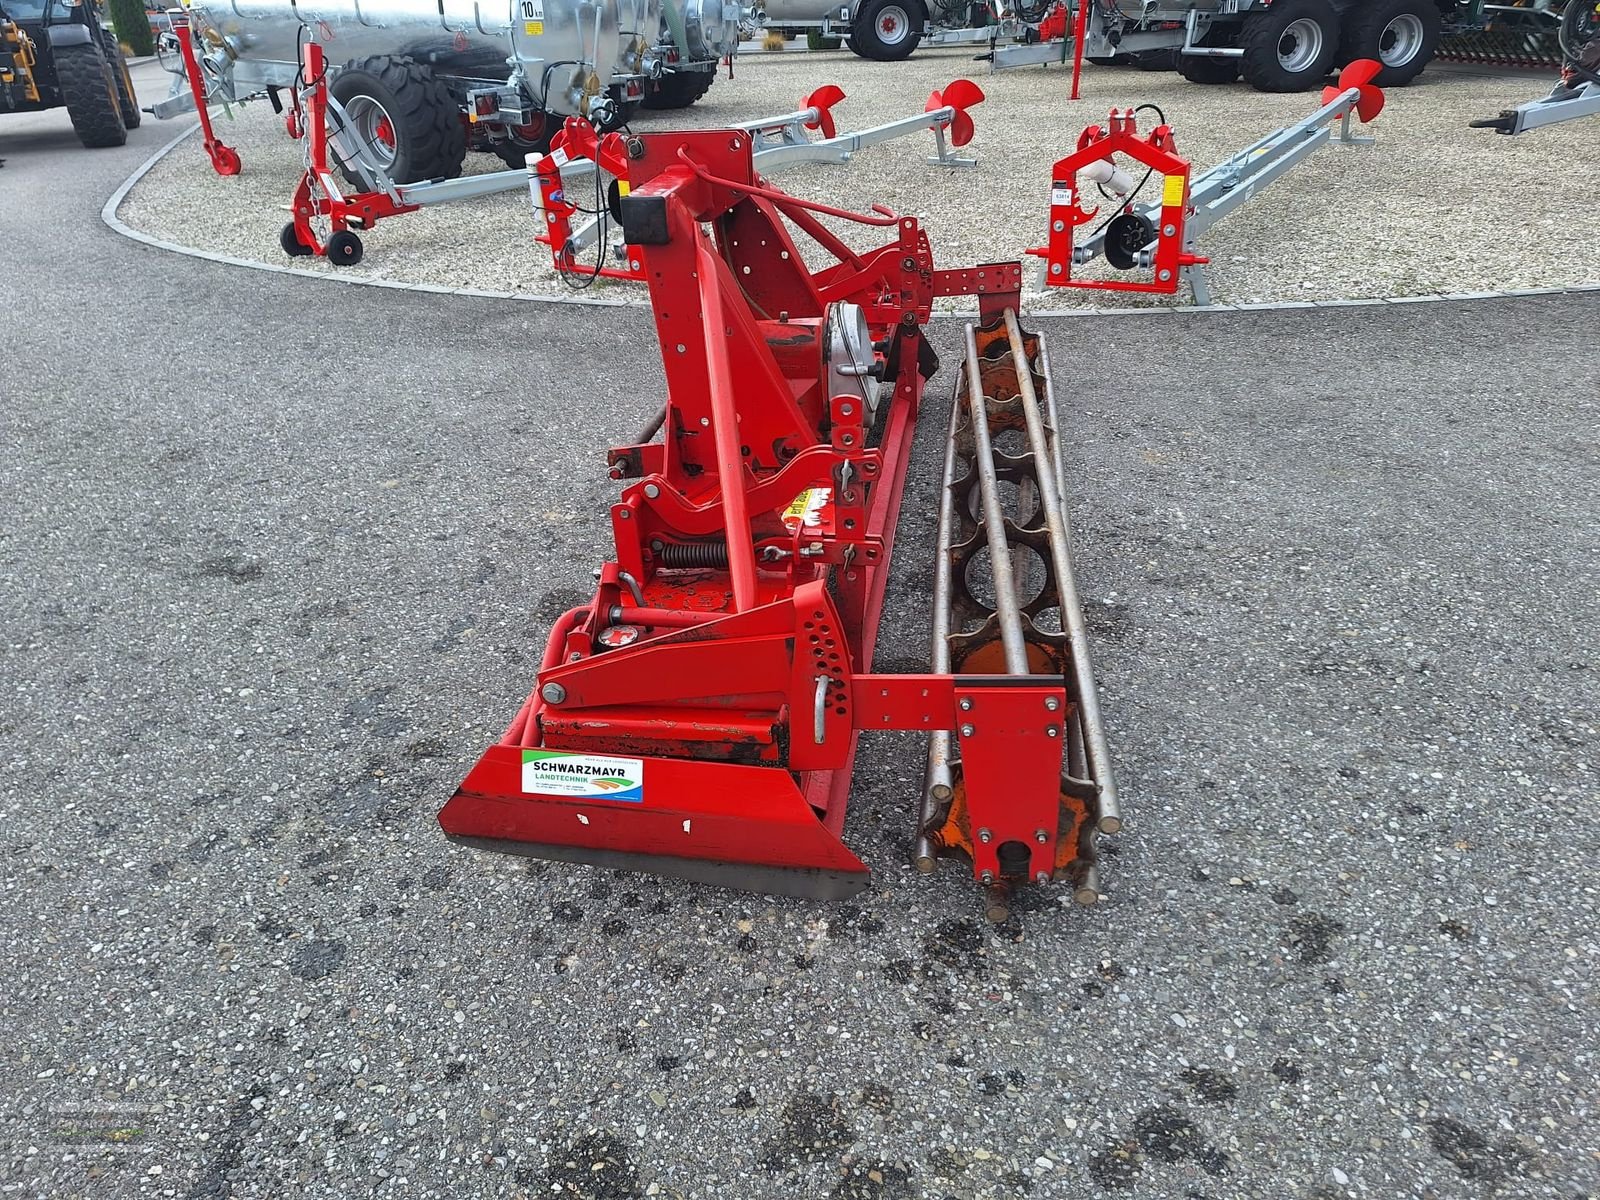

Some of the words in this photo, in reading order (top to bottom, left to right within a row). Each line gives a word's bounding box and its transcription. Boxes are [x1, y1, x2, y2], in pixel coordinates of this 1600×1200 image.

[522, 1, 534, 18] 10
[535, 9, 543, 17] km
[533, 762, 625, 777] SCHWARZMAYR
[535, 773, 589, 783] LANDTECHNIK
